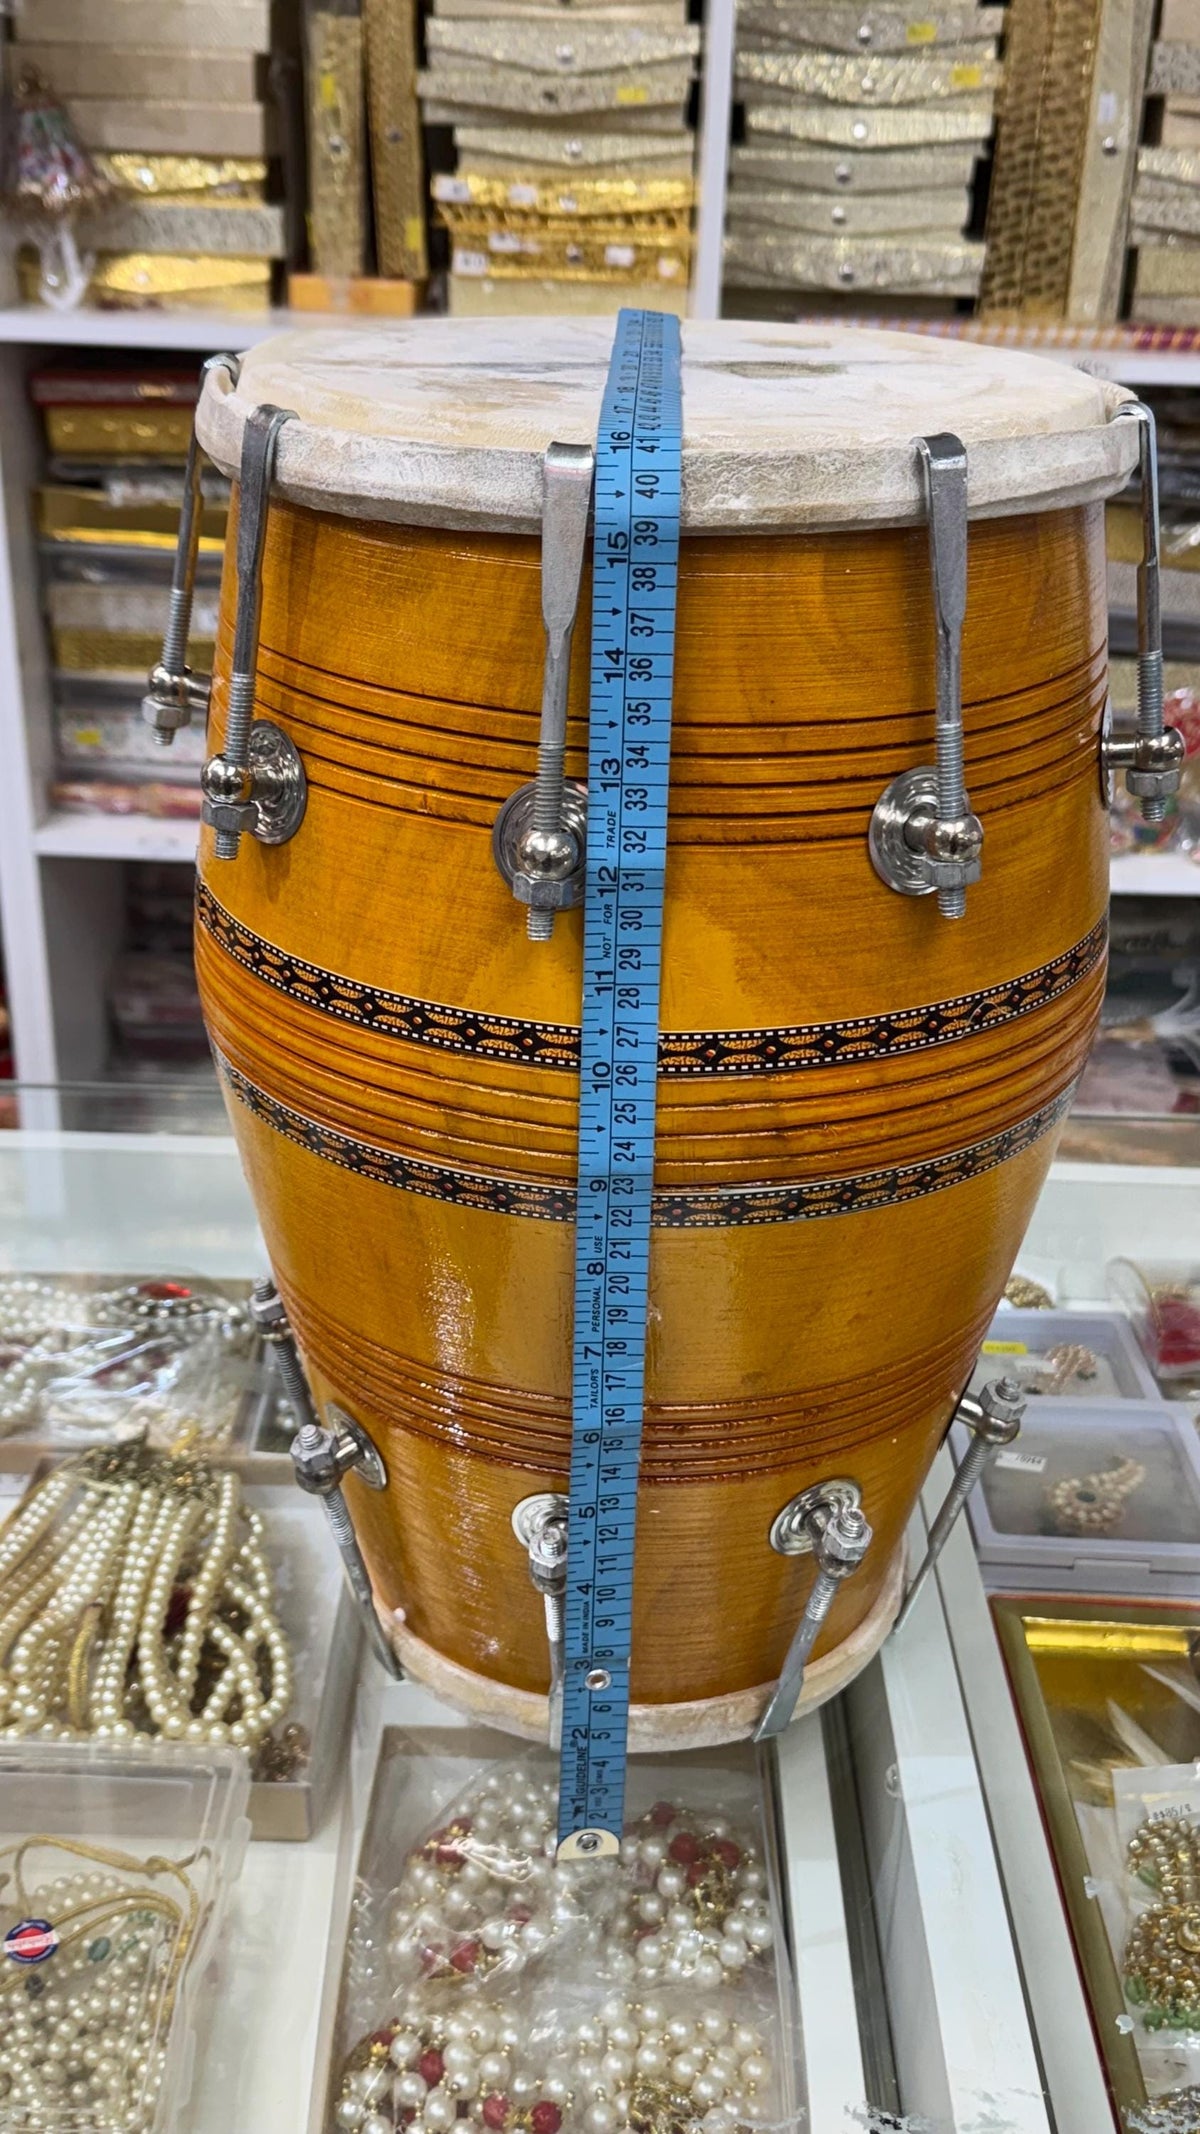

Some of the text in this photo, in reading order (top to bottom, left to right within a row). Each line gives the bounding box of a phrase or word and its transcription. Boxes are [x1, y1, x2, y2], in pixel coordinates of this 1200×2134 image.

[613, 405, 633, 414] 17
[636, 423, 661, 431] 42
[610, 431, 631, 454] 16
[635, 438, 661, 454] 41
[635, 474, 660, 499] 40
[633, 521, 659, 546] 39
[606, 531, 629, 568] 15
[632, 567, 656, 592] 38
[630, 612, 655, 637] 37
[603, 647, 624, 683] 14
[628, 657, 653, 682] 36
[627, 702, 651, 726] 35
[625, 745, 650, 769] 34
[600, 757, 621, 793] 13
[624, 787, 648, 811] 33
[622, 830, 647, 853] 32
[597, 865, 618, 898] 12
[602, 810, 617, 958] NOT FOR TRADE
[621, 871, 645, 892] 31
[619, 909, 643, 931] 30
[618, 948, 641, 971] 29
[594, 970, 614, 996] 11
[617, 987, 640, 1010] 28
[616, 1026, 639, 1049] 27
[591, 1061, 611, 1093] 10
[615, 1064, 638, 1087] 26
[614, 1102, 637, 1125] 25
[613, 1141, 636, 1162] 24
[589, 1179, 607, 1193] 9
[612, 1177, 634, 1195] 23
[610, 1208, 632, 1228] 22
[609, 1241, 631, 1260] 21
[586, 1261, 604, 1275] 8
[608, 1275, 630, 1295] 20
[590, 1235, 603, 1409] TAILOR'S PERSONAL USE
[607, 1307, 628, 1326] 19
[583, 1345, 602, 1360] 7
[606, 1341, 627, 1358] 18
[605, 1373, 626, 1391] 17
[605, 1407, 625, 1427] 16
[583, 1431, 600, 1444] 6
[603, 1438, 624, 1454] 15
[601, 1466, 622, 1483] 14
[578, 1506, 595, 1519] 5
[599, 1497, 620, 1514] 13
[598, 1526, 619, 1545] 12
[597, 1556, 618, 1575] 11
[576, 1582, 593, 1595] 4
[596, 1587, 617, 1605] 10
[581, 1600, 590, 1654] MADE IN INDIA
[595, 1618, 615, 1628] 9
[595, 1649, 614, 1658] 8
[574, 1659, 590, 1670] 3
[593, 1704, 612, 1714] 6
[571, 1727, 588, 1740] 2
[591, 1731, 611, 1740] 5
[575, 1745, 587, 1795] GUIDELINE
[592, 1760, 610, 1769] 4
[590, 1787, 609, 1797] 3
[589, 1812, 608, 1820] 2
